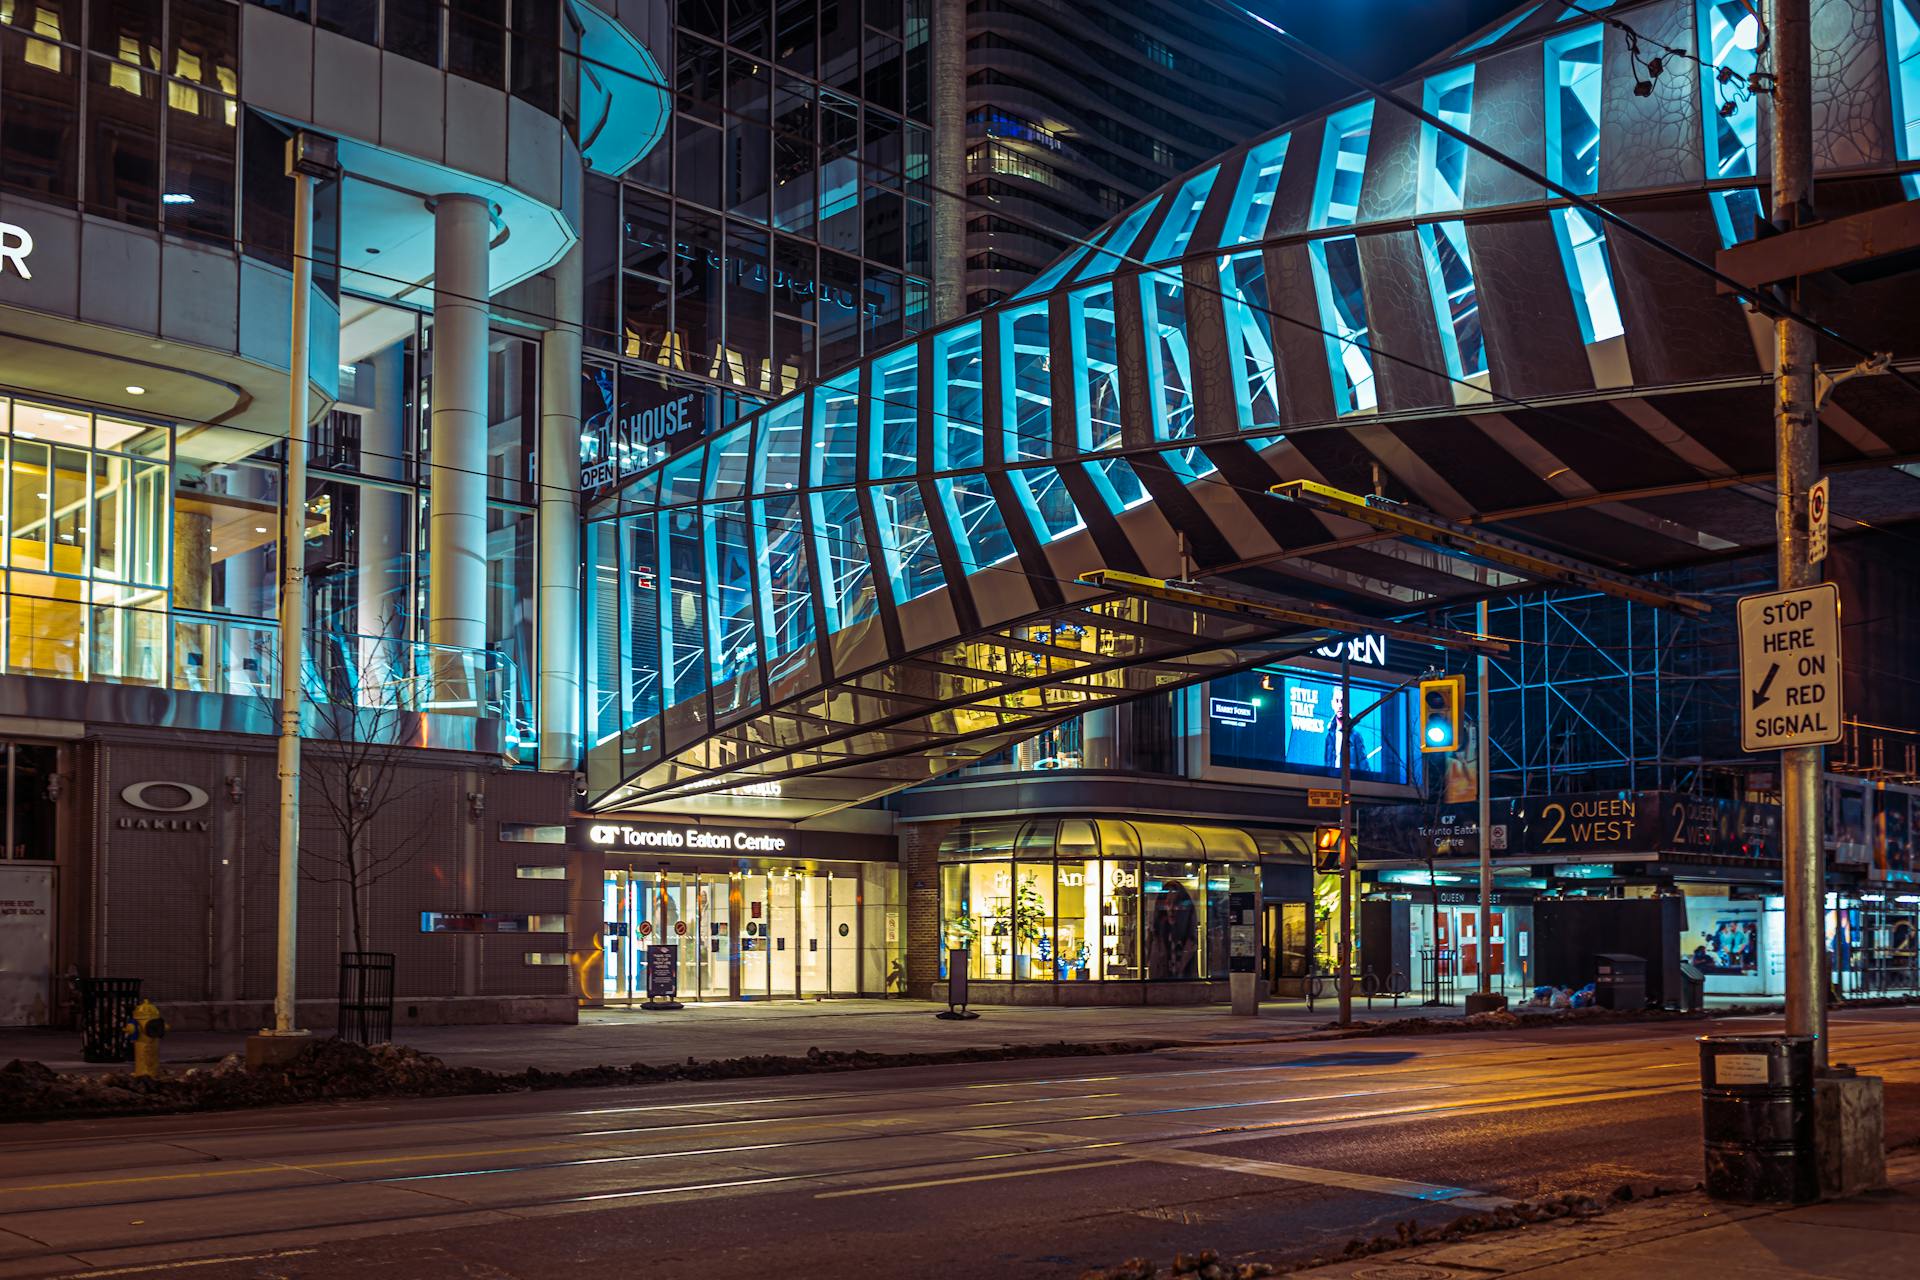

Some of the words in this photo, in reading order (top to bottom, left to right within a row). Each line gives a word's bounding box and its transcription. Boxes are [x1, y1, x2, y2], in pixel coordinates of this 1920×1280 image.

[581, 463, 613, 489] OPEN
[1763, 600, 1812, 625] STOP
[1764, 628, 1815, 653] HERE
[1798, 655, 1825, 676] ON
[1290, 686, 1318, 704] STYLE
[1786, 684, 1825, 706] RED
[1290, 701, 1315, 717] THAT
[1291, 715, 1324, 733] WORKS
[1755, 713, 1828, 738] SIGNAL
[1542, 803, 1567, 844] 2
[1570, 800, 1635, 818] QUEEN
[1571, 821, 1635, 842] WEST
[1672, 803, 1685, 843] 2
[621, 827, 683, 847] Toronto
[686, 830, 731, 848] Eaton
[734, 832, 785, 850] Centre
[1441, 893, 1465, 902] QUEEN
